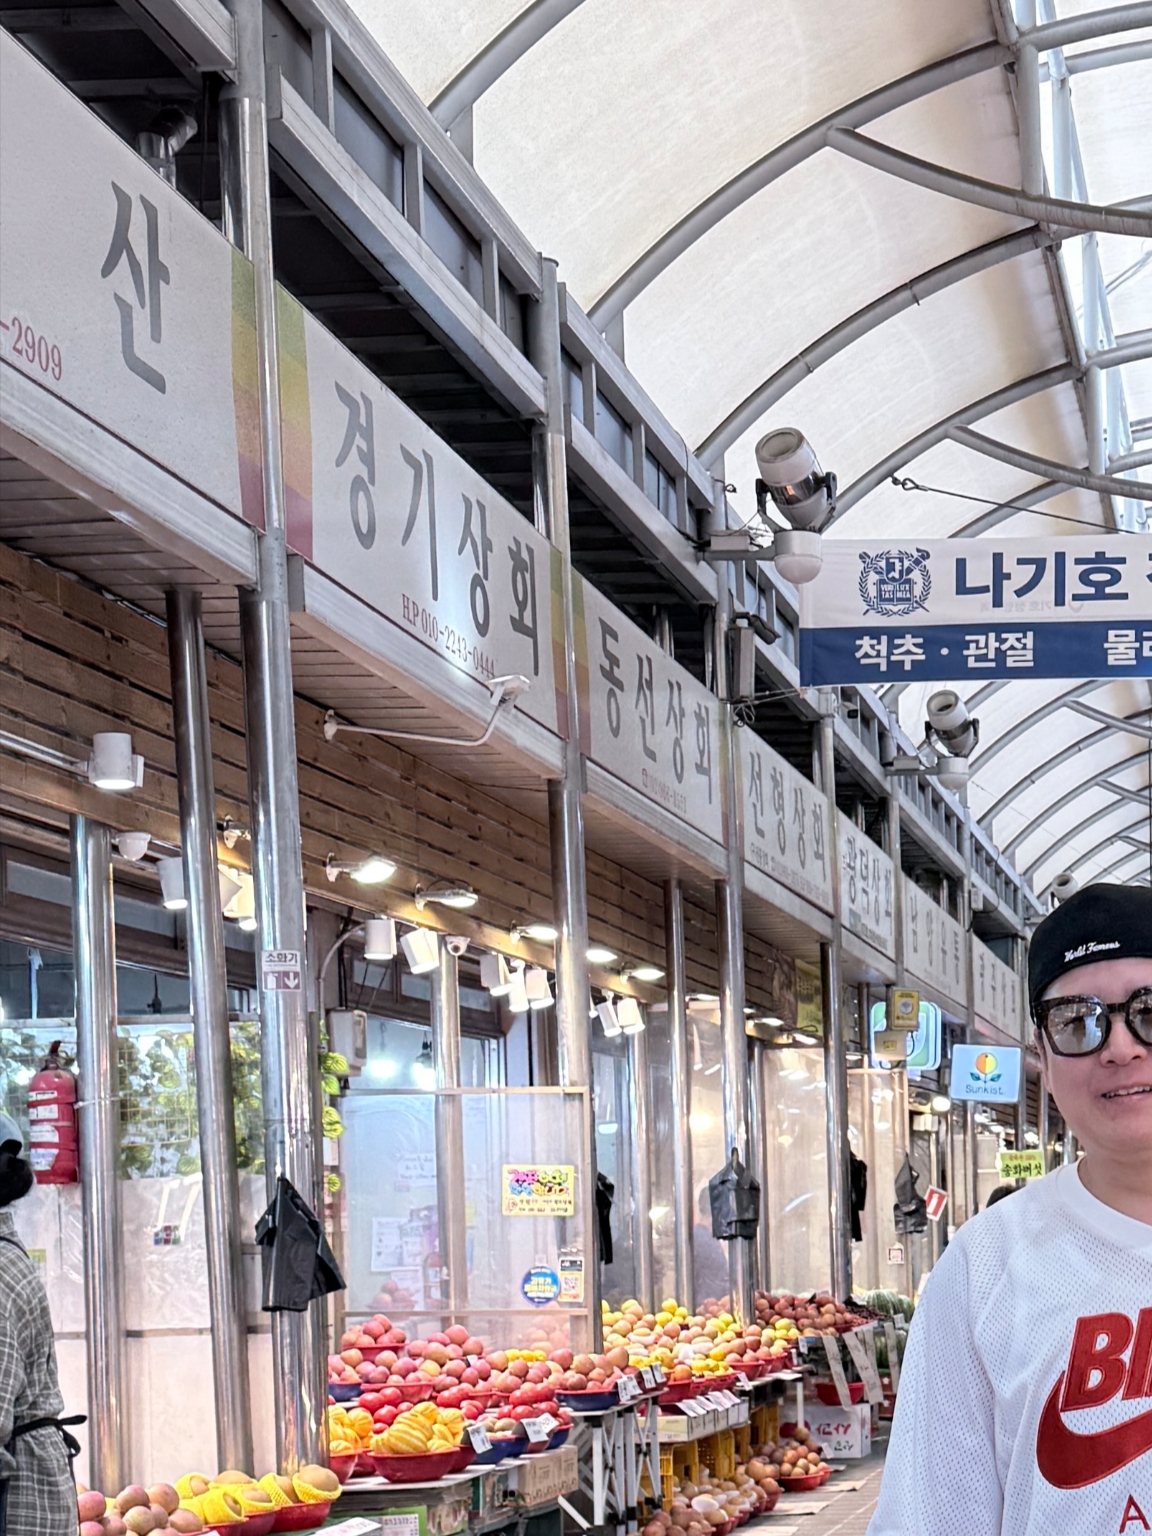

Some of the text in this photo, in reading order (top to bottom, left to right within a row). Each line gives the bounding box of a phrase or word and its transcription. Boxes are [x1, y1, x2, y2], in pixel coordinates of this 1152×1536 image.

[335, 381, 540, 677] 경기상회
[954, 551, 1129, 608] 나기호
[421, 608, 495, 679] 010-2243-0444
[854, 634, 926, 672] 척추
[962, 631, 1035, 669] 관절
[598, 617, 712, 805] 동선상회
[265, 952, 298, 964] 소화기
[965, 1083, 1004, 1096] Sunkist
[1002, 1163, 1043, 1177] 송화버섯
